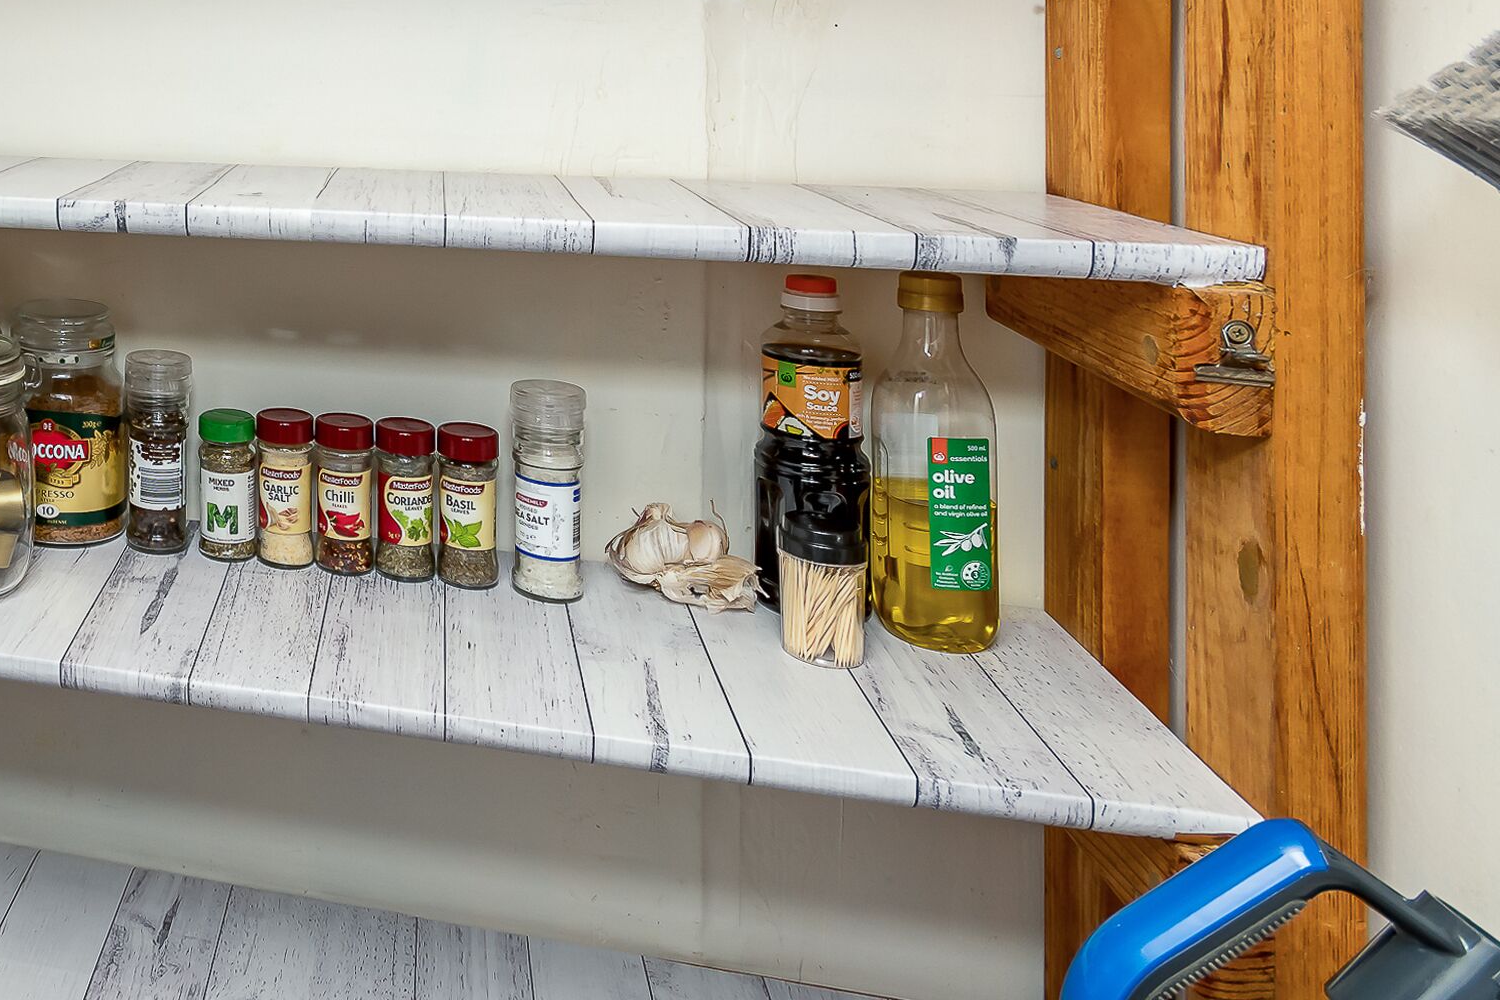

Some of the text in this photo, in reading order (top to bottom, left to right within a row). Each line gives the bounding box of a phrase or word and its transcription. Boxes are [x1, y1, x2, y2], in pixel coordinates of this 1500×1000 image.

[803, 384, 840, 405] Soy
[806, 402, 838, 412] Sauce
[43, 422, 52, 430] DE
[30, 443, 86, 460] OCCONA
[208, 477, 235, 487] MIXED
[932, 469, 975, 484] olive
[263, 480, 299, 495] GARLIC
[932, 485, 956, 499] oil
[268, 492, 291, 503] SALT
[325, 489, 355, 504] Chilli
[386, 492, 432, 506] CORIANDE
[446, 494, 476, 511] BASIL
[41, 506, 55, 515] 10
[207, 502, 238, 535] M
[525, 512, 550, 526] SALT
[973, 571, 978, 579] 3
